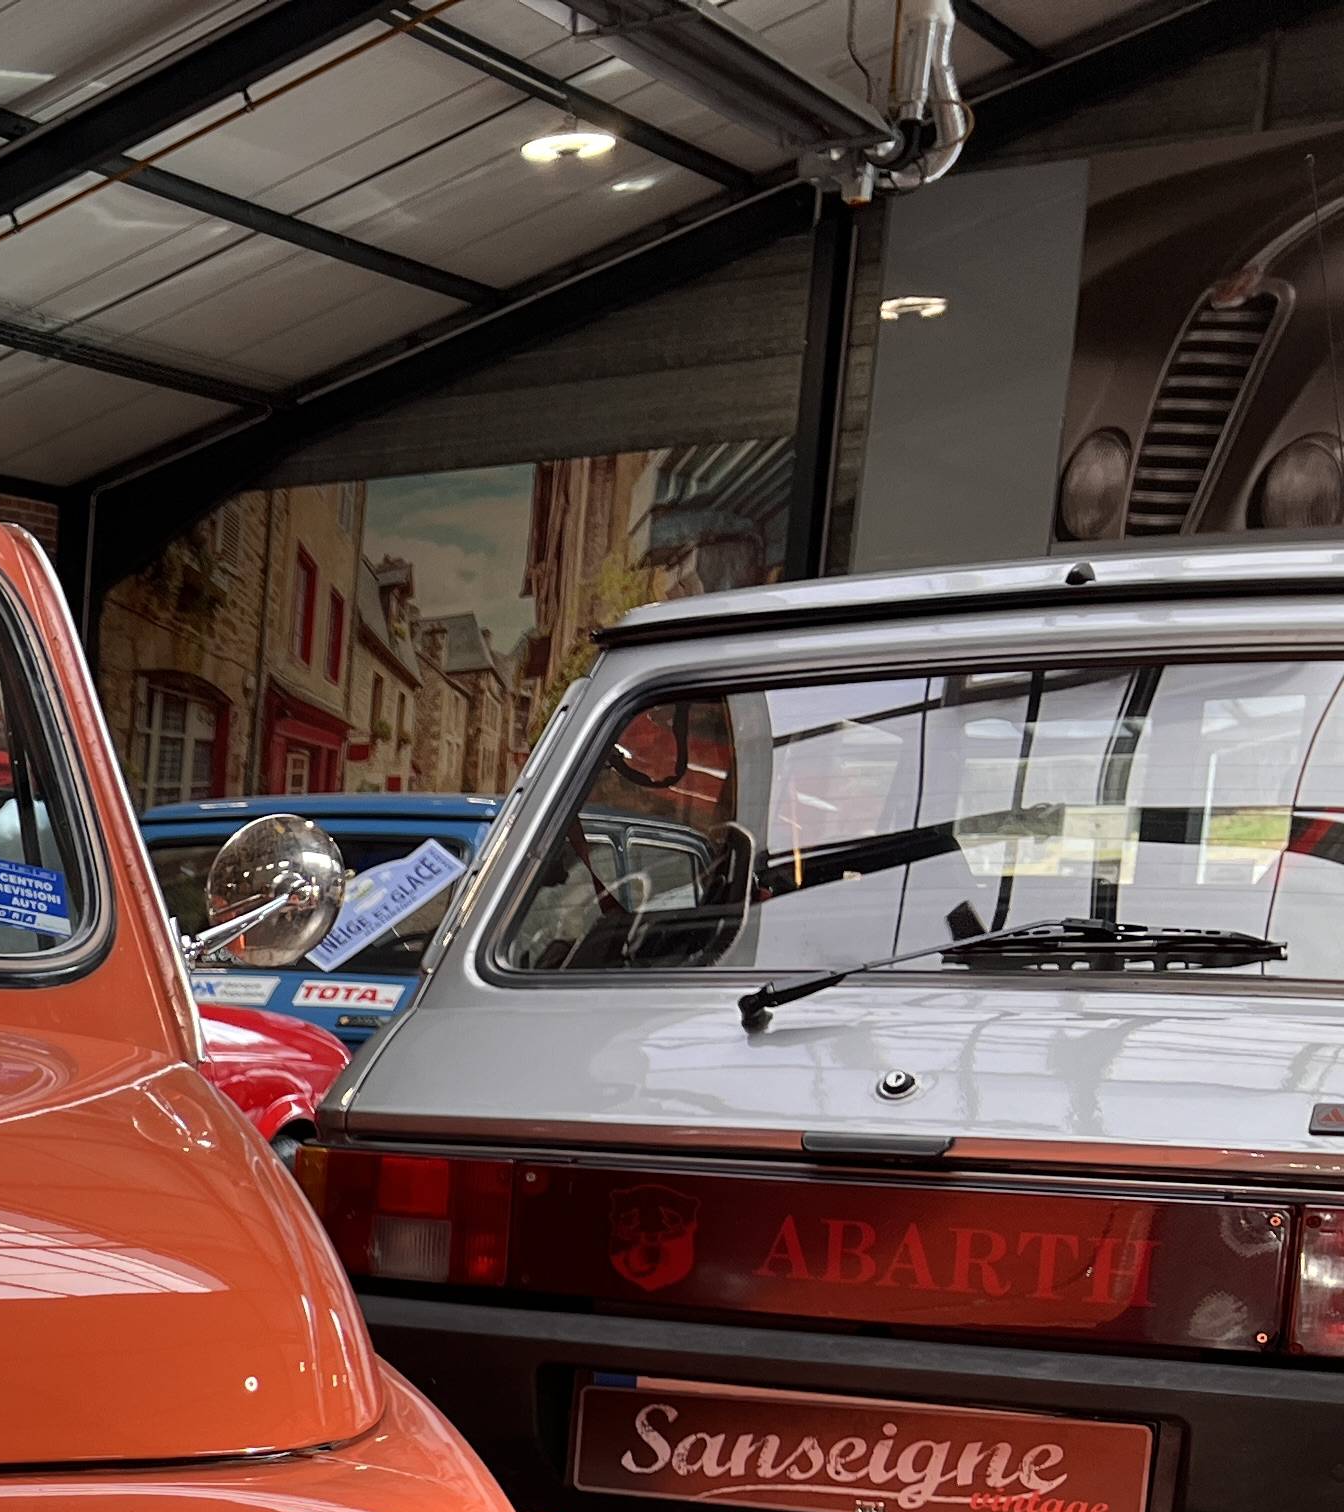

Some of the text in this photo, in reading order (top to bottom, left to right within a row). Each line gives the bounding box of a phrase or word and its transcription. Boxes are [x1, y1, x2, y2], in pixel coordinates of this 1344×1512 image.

[11, 896, 49, 912] AUTO
[320, 914, 372, 954] NEIGE
[391, 857, 444, 906] GLACE
[751, 1213, 1162, 1309] ABARTH
[620, 1403, 1069, 1510] Sanseigne
